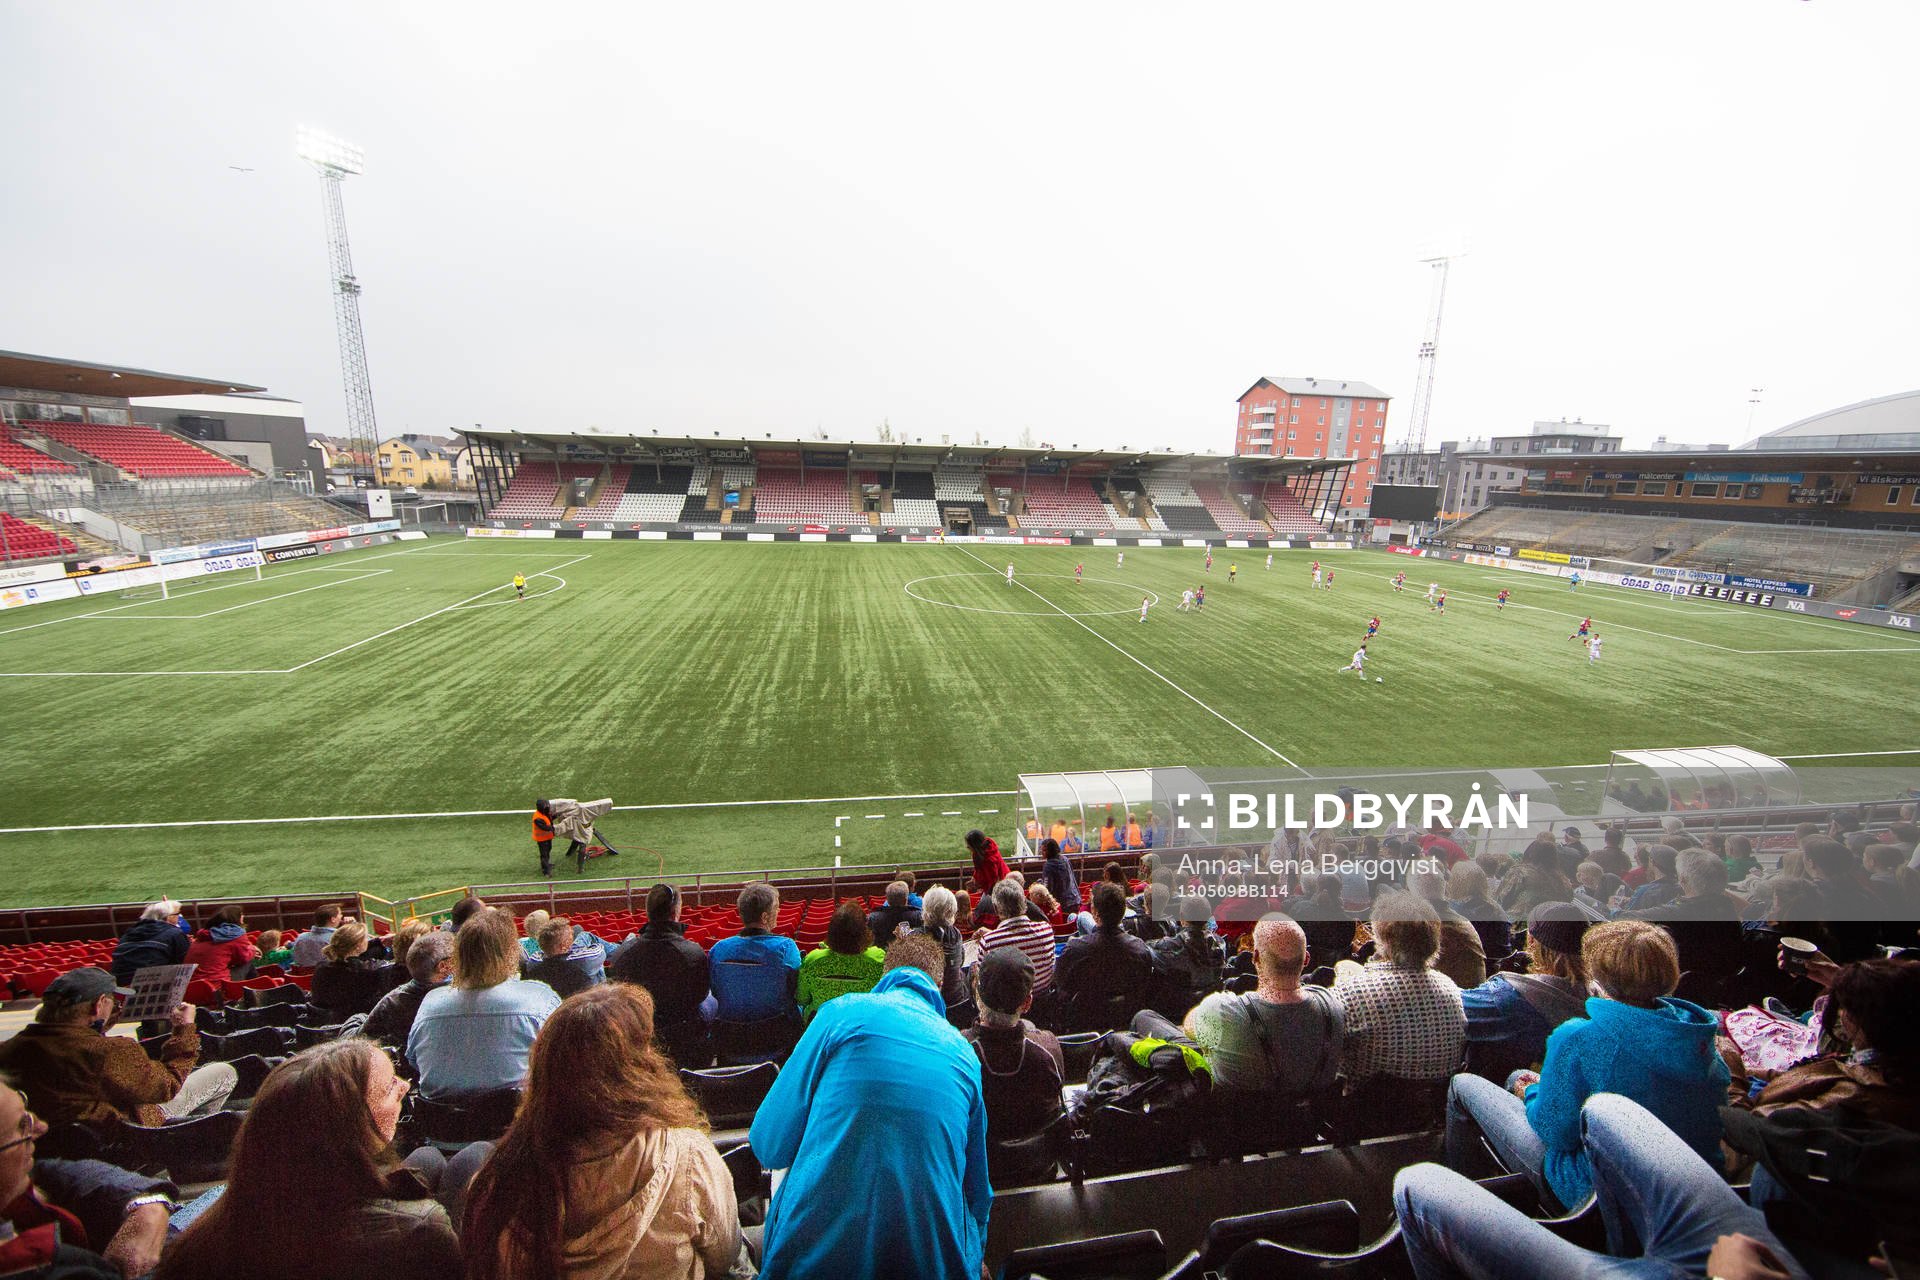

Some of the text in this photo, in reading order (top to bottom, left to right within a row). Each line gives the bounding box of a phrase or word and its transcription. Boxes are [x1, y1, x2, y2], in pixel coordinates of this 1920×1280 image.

[274, 546, 317, 560] CONVENTUM
[1621, 575, 1650, 589] ÖBAB
[1744, 577, 1761, 585] HOTEL
[1691, 585, 1772, 606] E E E E E E
[1785, 600, 1806, 612] NA
[1887, 615, 1911, 628] NA
